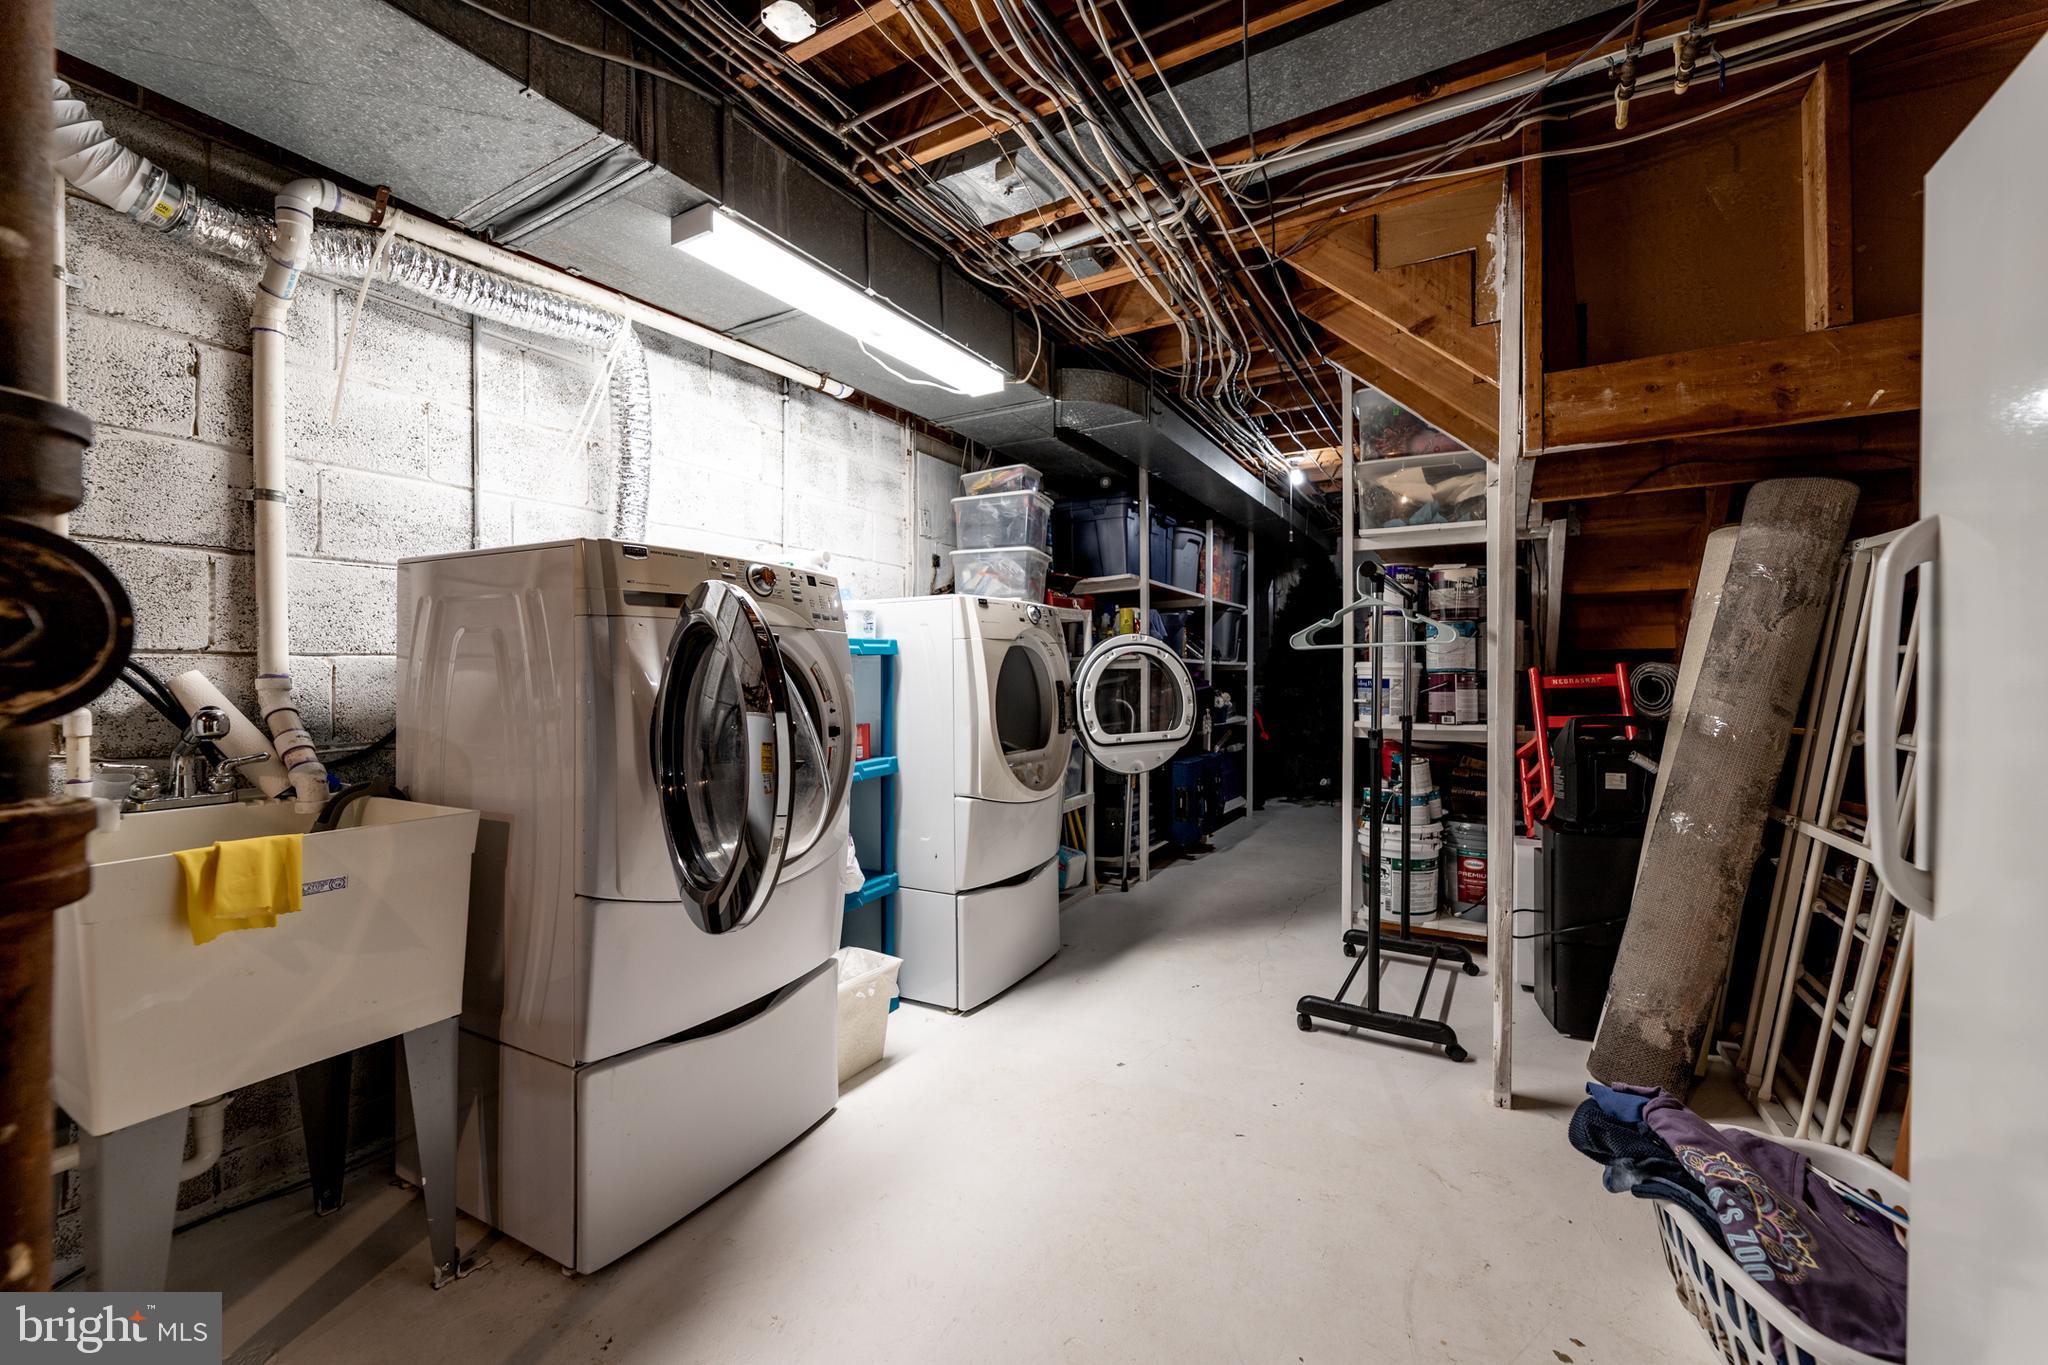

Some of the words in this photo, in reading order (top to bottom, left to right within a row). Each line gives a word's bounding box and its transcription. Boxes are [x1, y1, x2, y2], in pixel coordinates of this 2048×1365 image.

[1457, 870, 1487, 880] PREMIU
[1708, 1187, 1745, 1226] A'S
[1727, 1229, 1777, 1282] ZOO
